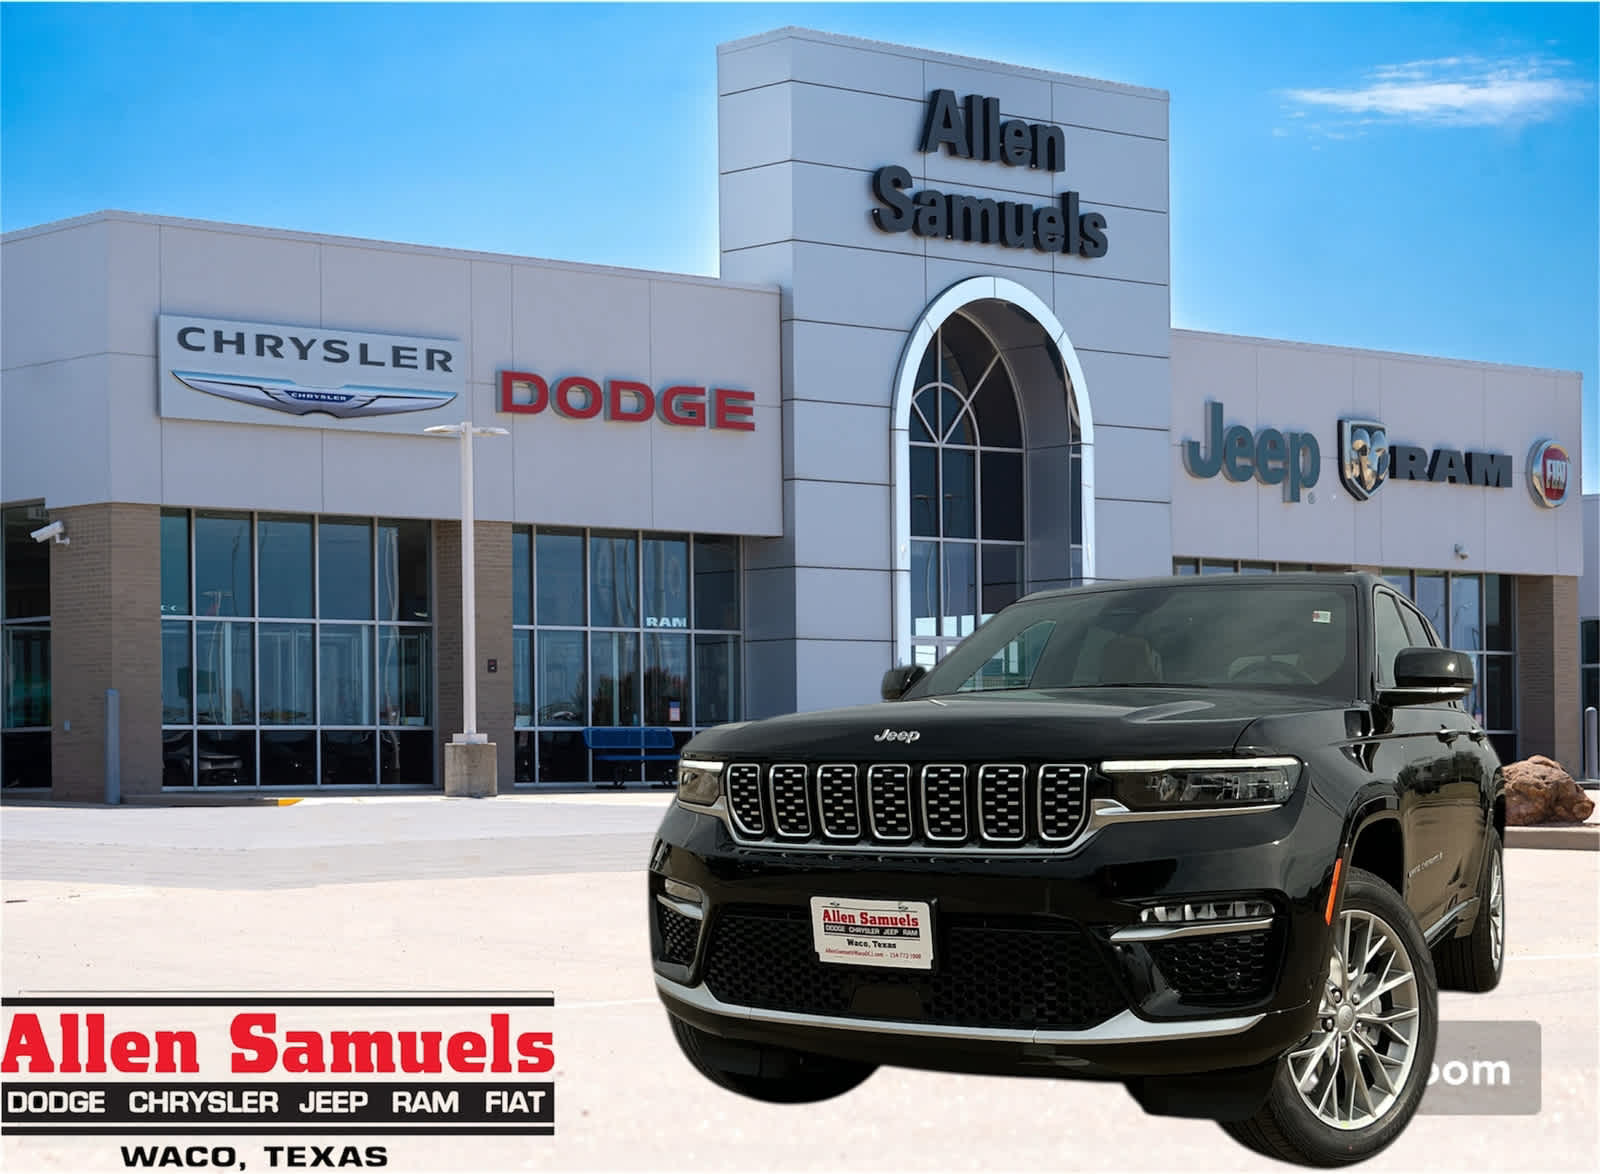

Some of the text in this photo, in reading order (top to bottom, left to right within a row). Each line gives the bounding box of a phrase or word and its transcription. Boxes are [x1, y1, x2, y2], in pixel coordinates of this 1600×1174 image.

[919, 88, 1066, 172] Allen
[871, 165, 1108, 258] Samuels
[177, 326, 454, 373] CHRYSLER
[290, 391, 347, 401] CHRYSLER
[496, 369, 755, 431] DODGE
[1182, 400, 1321, 503] Jeep
[1389, 445, 1513, 488] RAM
[646, 616, 688, 628] RAM
[874, 728, 920, 744] Jeep
[823, 909, 919, 927] Allen Samuels
[846, 938, 897, 949] Waco, Texas
